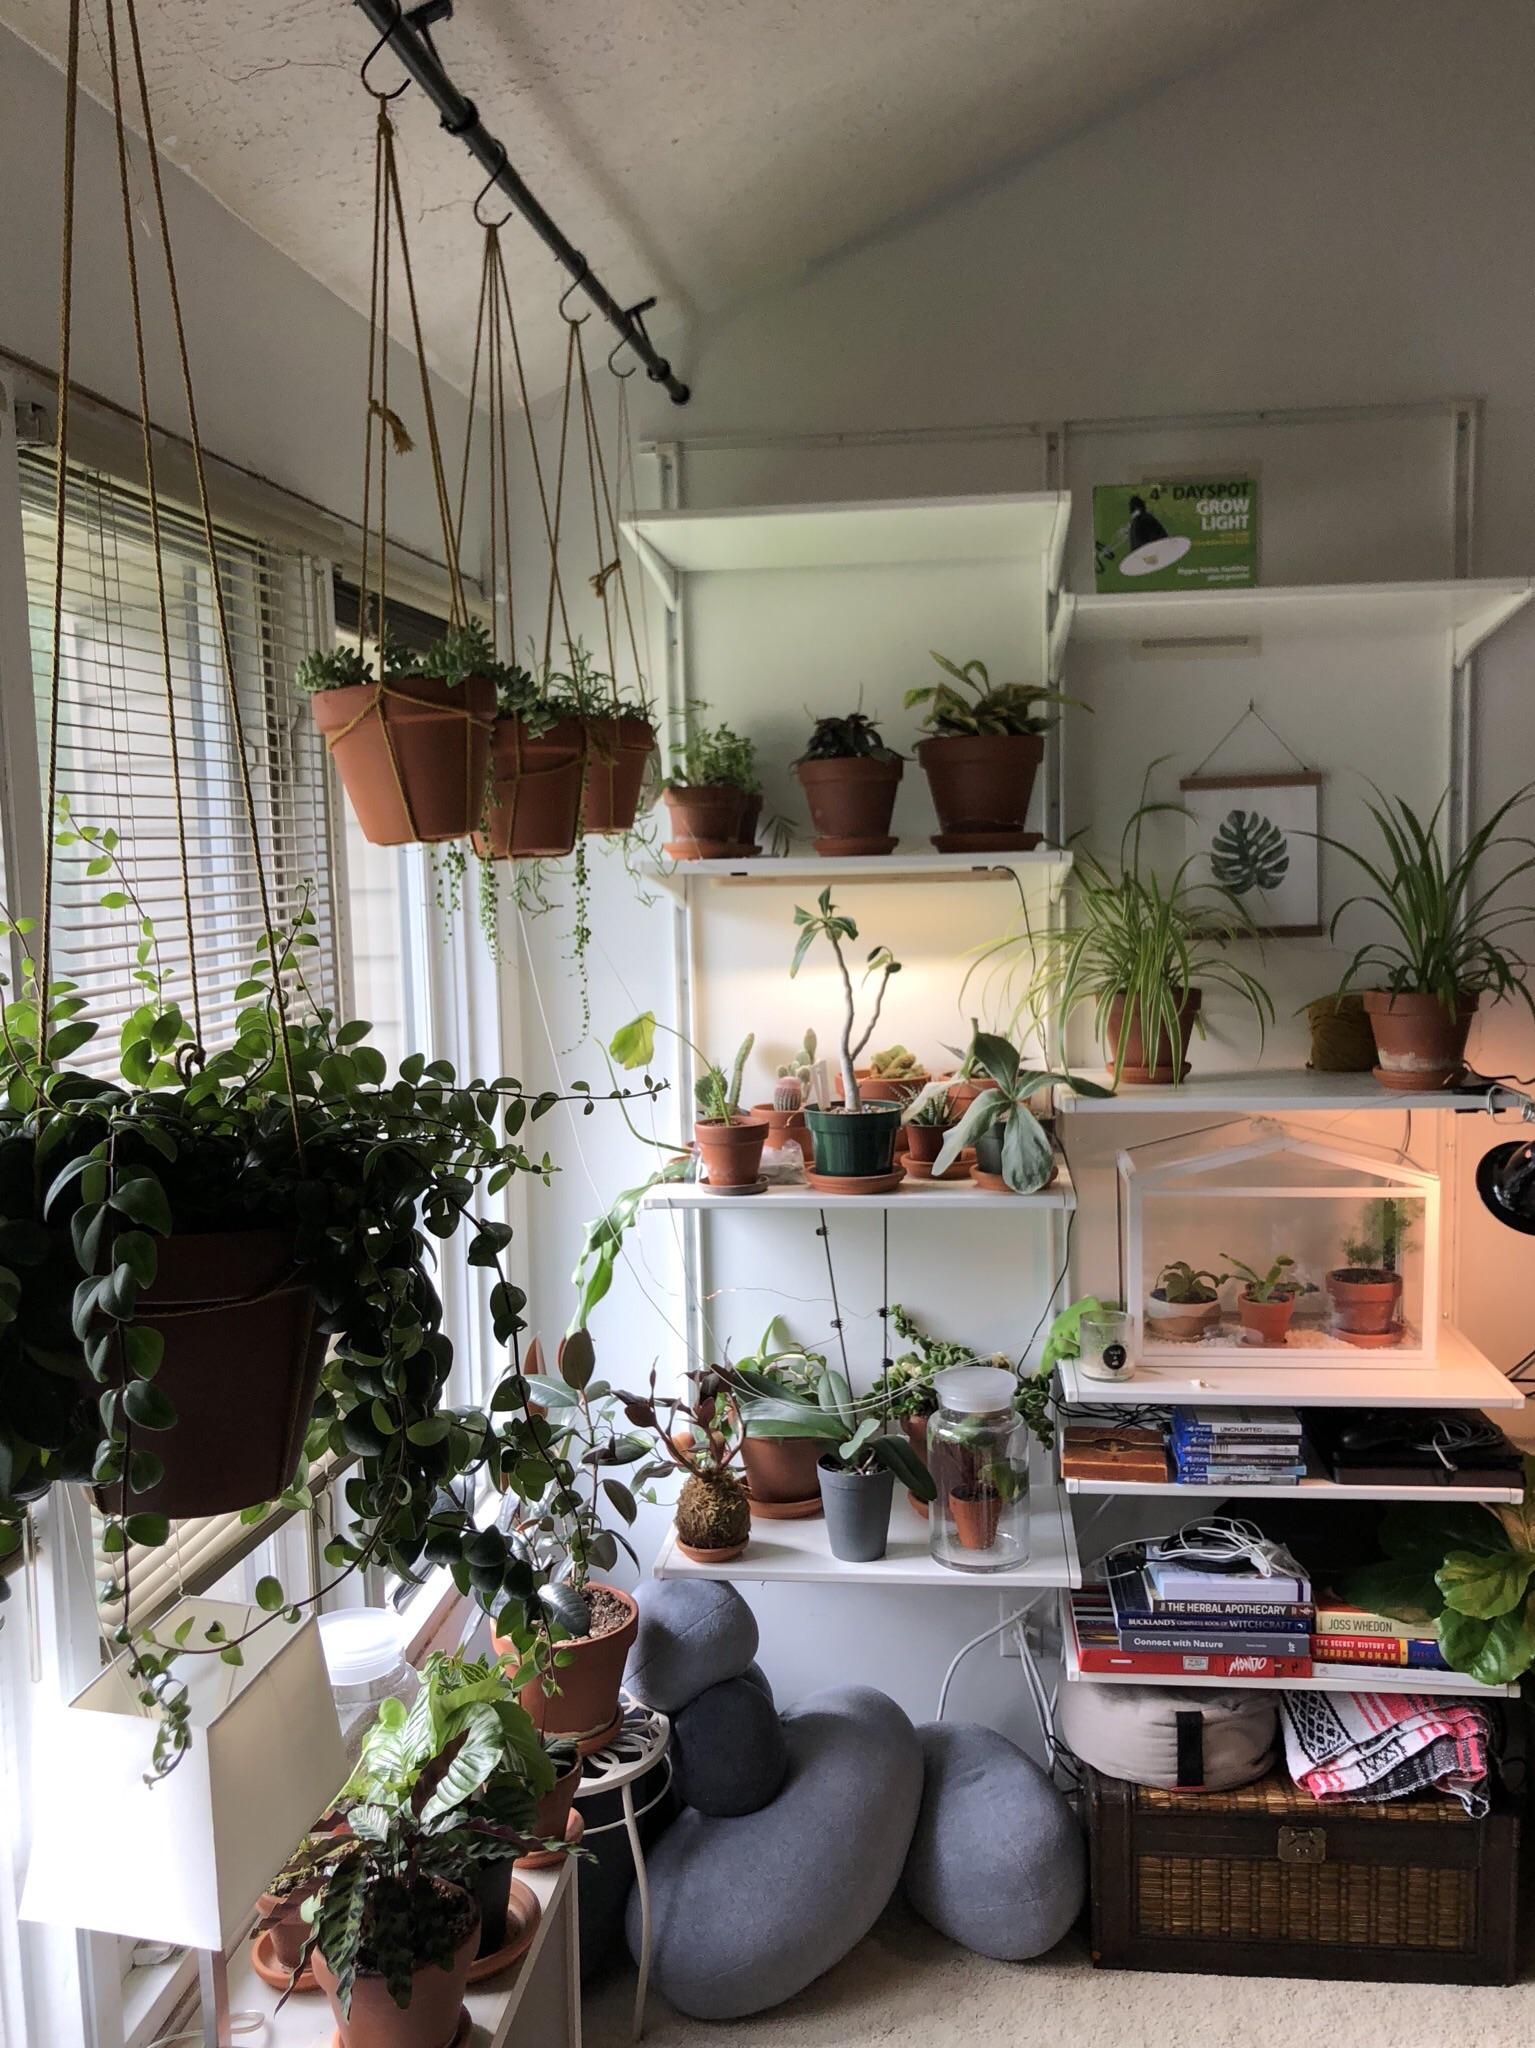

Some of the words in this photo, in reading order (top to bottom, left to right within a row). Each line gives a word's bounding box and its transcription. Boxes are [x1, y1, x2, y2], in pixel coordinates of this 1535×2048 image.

[1172, 482, 1250, 500] DAYSPOT
[1196, 499, 1250, 515] GROW
[1201, 515, 1250, 531] LIGHT
[1167, 1602, 1185, 1612] THE
[1186, 1603, 1223, 1613] HERBAL
[1224, 1604, 1287, 1615] APOTHECARY
[1128, 1618, 1176, 1626] BUCKLAND'S
[1229, 1619, 1292, 1630] WITCHCRAFT
[1328, 1618, 1352, 1631] JOSS
[1353, 1620, 1393, 1633] WHEDON
[1133, 1637, 1171, 1646] Connect
[1172, 1639, 1192, 1647] with
[1193, 1640, 1224, 1648] Nature
[1316, 1639, 1328, 1647] THE
[1330, 1640, 1355, 1649] SECRET
[1357, 1641, 1384, 1650] HISTORY
[1387, 1642, 1396, 1650] OF
[1316, 1648, 1354, 1659] WONDER
[1359, 1651, 1397, 1661] WOMAN
[1228, 1655, 1267, 1676] MONDO
